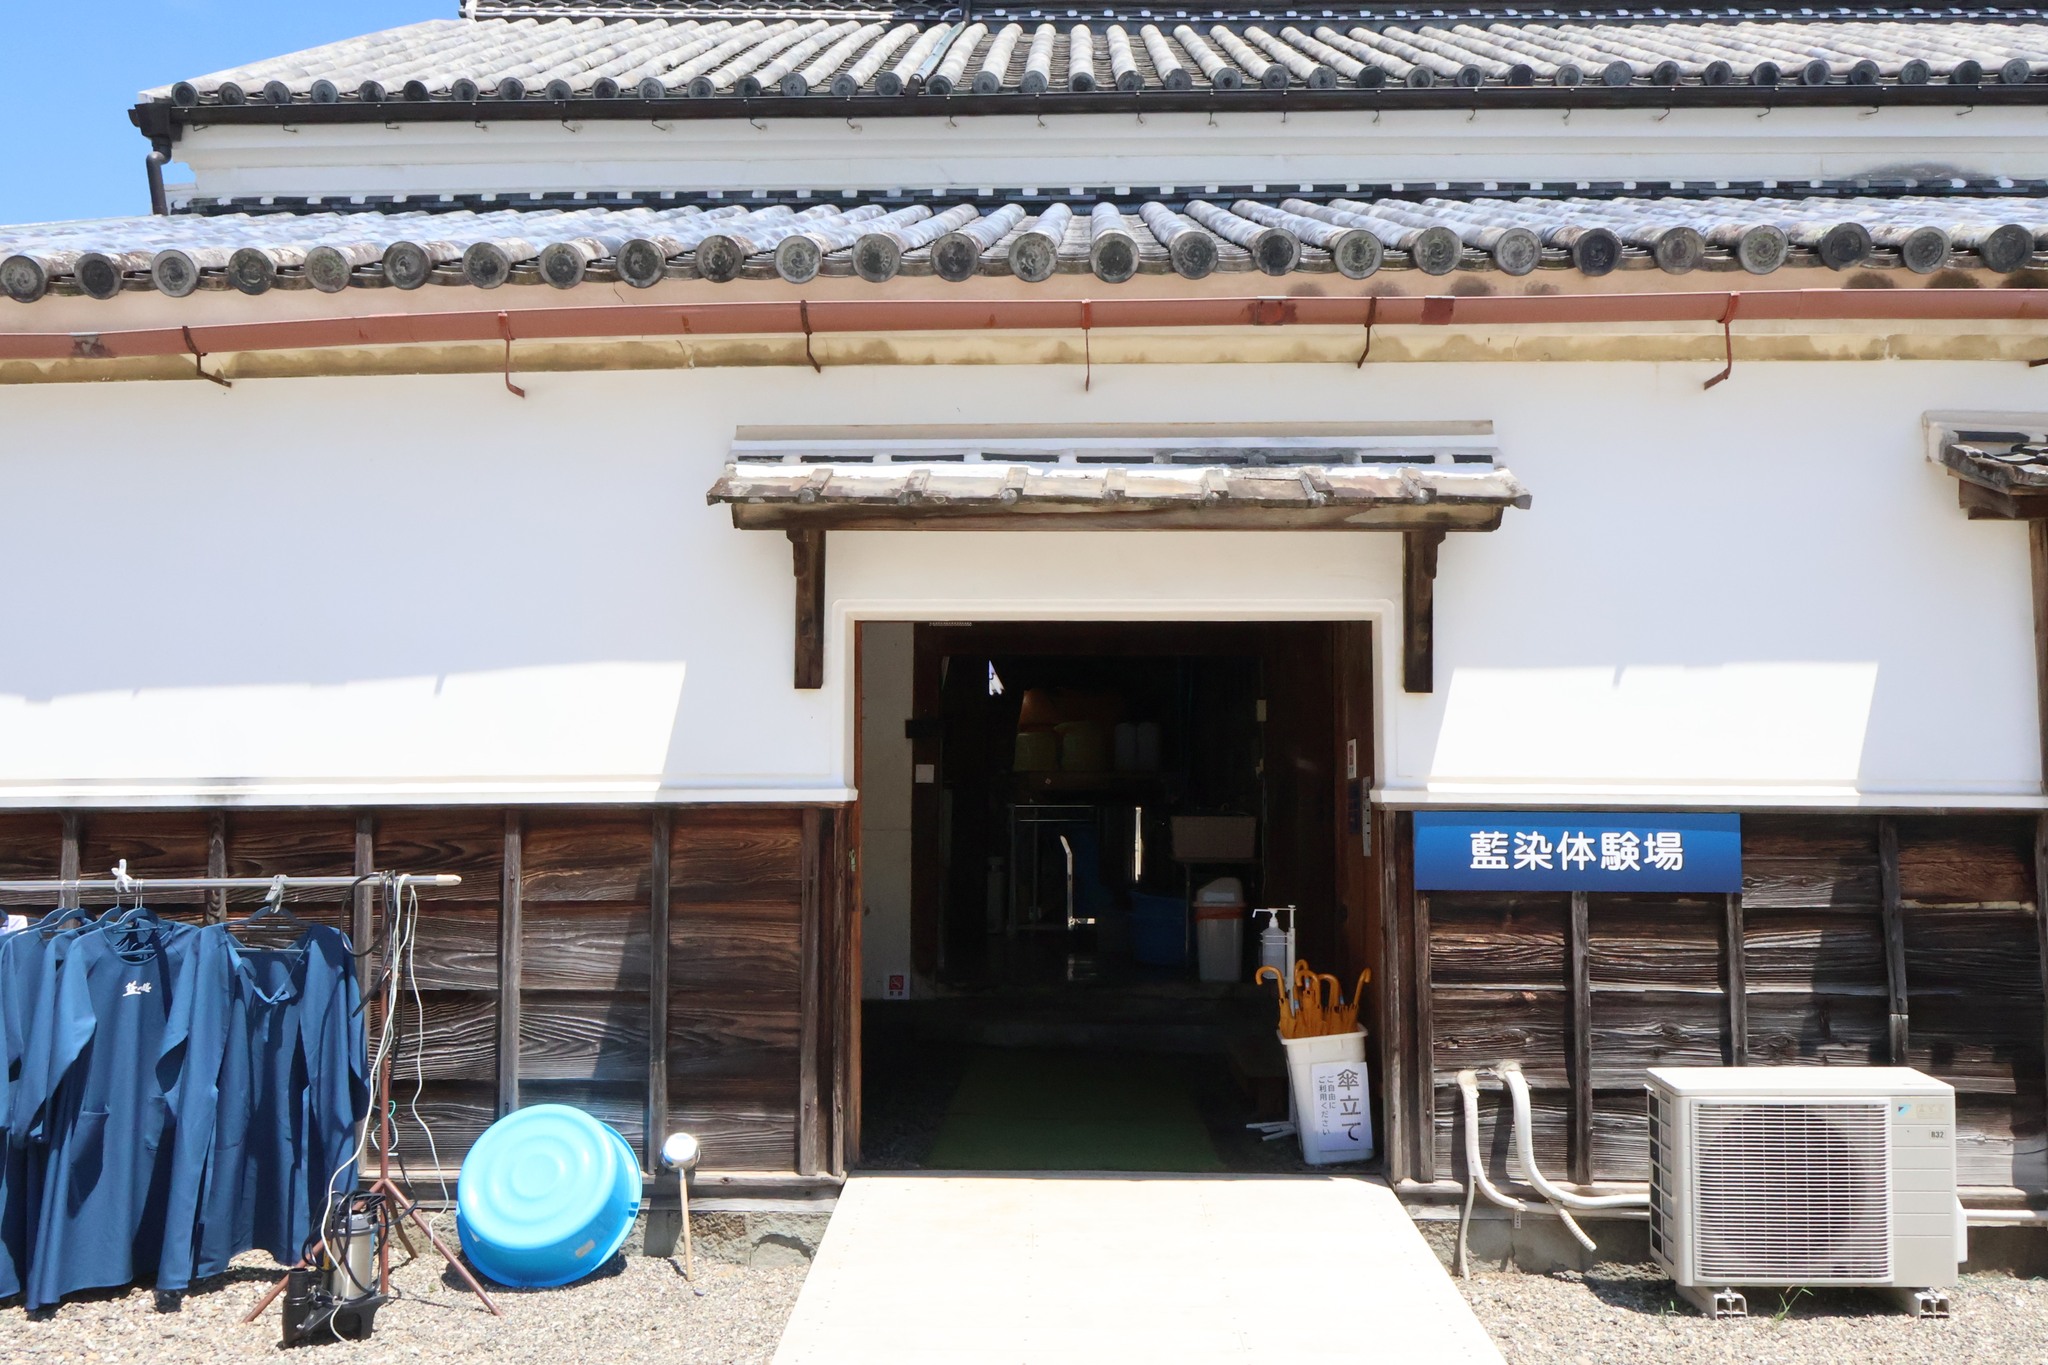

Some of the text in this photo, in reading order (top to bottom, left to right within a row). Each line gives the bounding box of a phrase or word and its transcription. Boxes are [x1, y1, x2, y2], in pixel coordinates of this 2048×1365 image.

[1469, 830, 1684, 871] 藍染体験場
[1319, 1075, 1331, 1136] ご利用ください
[1327, 1075, 1336, 1109] ご自由に
[1337, 1069, 1361, 1141] 傘立て
